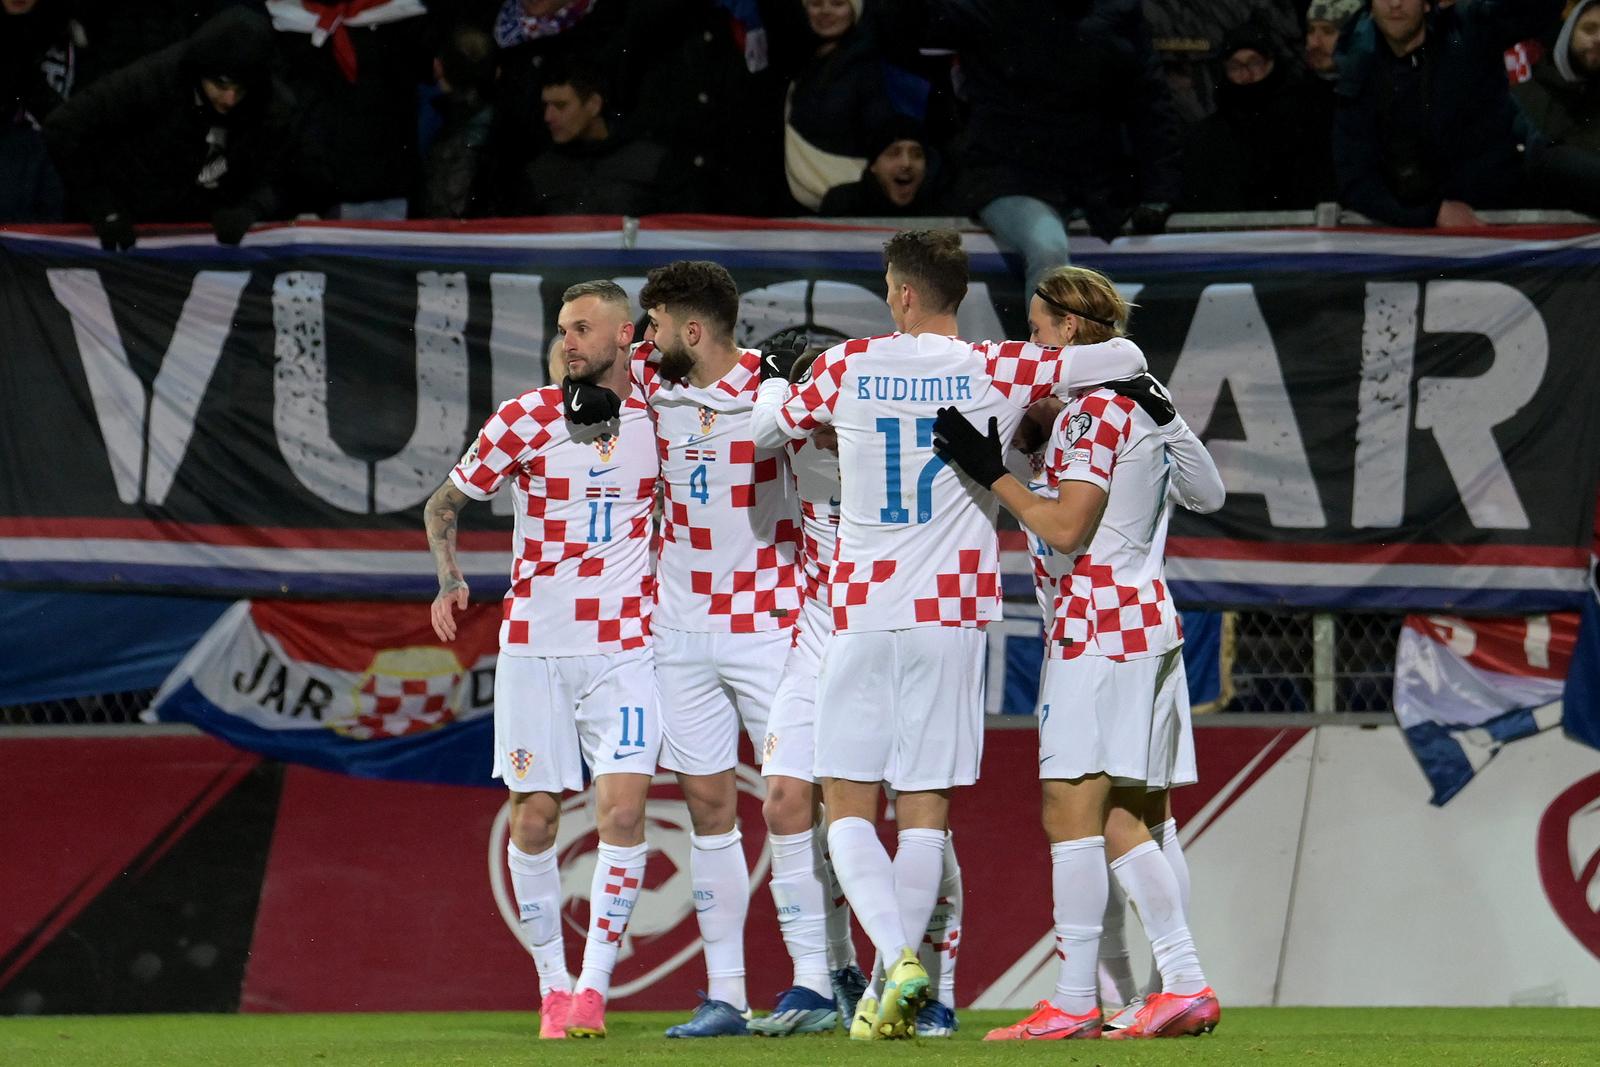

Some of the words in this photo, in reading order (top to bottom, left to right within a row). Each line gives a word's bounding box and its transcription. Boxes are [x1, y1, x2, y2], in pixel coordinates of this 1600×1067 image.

[47, 269, 1549, 530] VUAR
[857, 375, 972, 401] BUDIMIR
[690, 464, 709, 504] 4
[876, 417, 950, 524] 17
[587, 502, 612, 542] 11
[232, 650, 334, 720] JAR
[619, 706, 646, 747] 11
